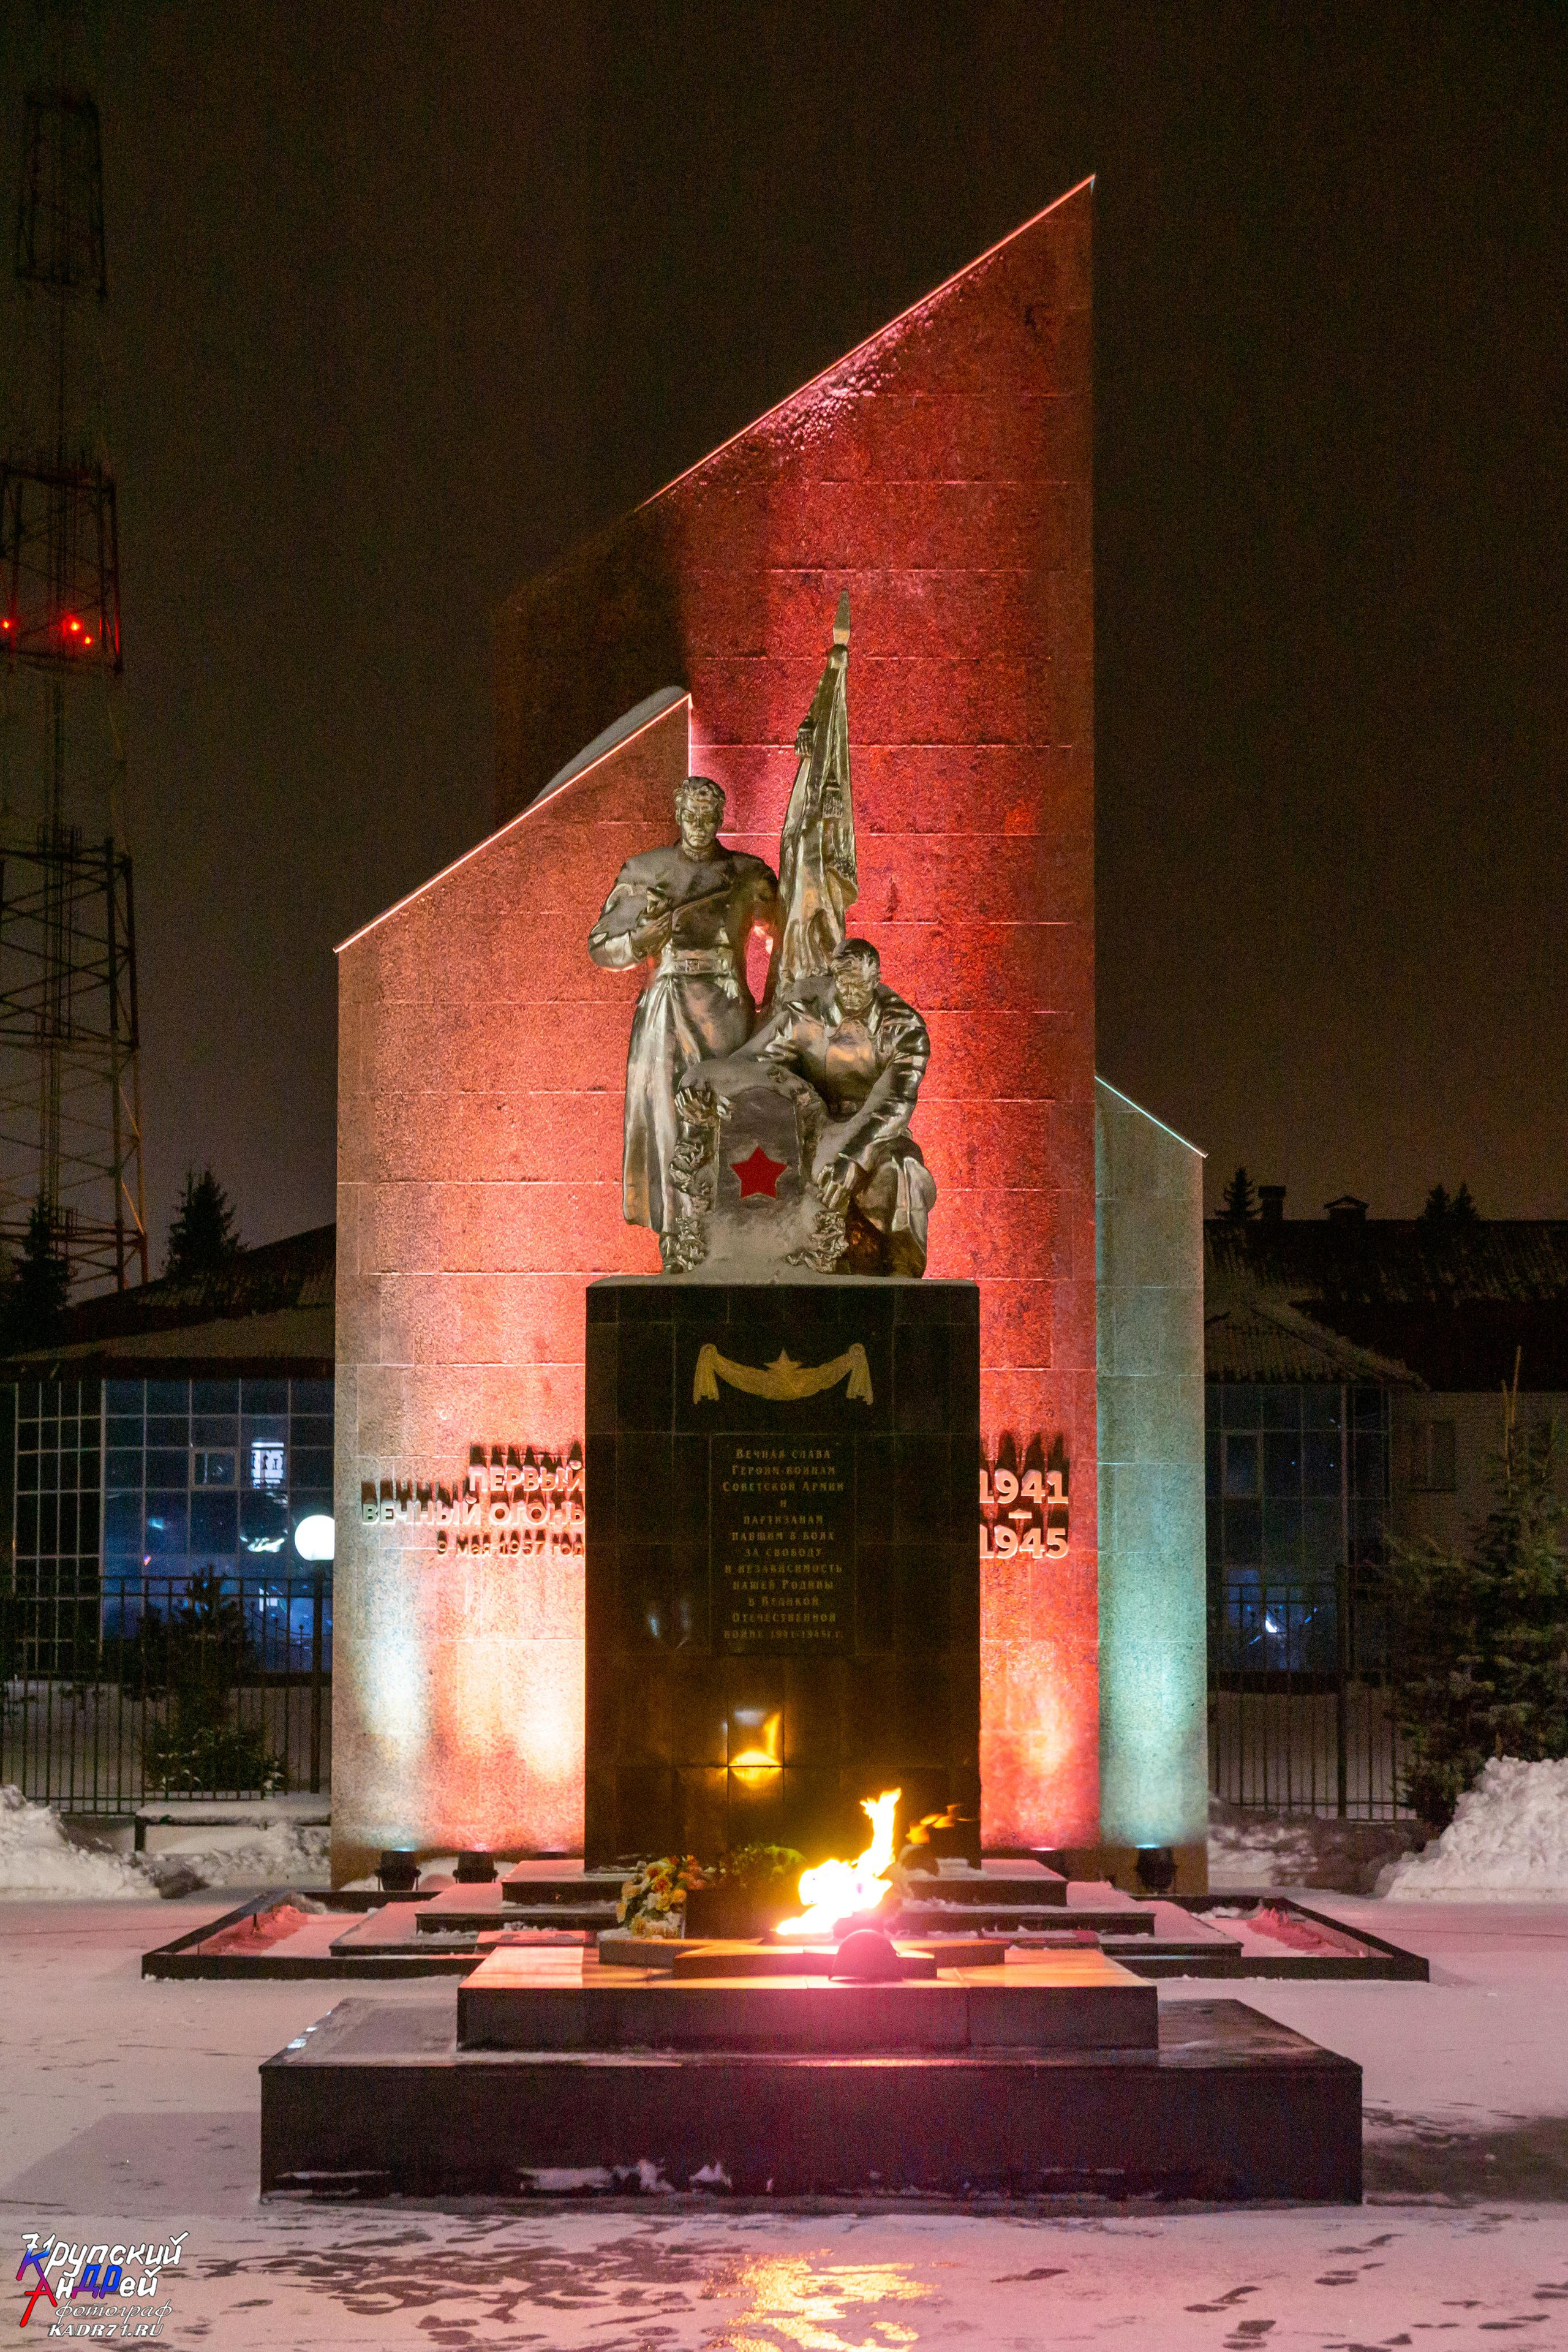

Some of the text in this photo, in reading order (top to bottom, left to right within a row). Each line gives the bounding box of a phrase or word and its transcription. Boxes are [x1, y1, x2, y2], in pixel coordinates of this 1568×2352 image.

[469, 1460, 586, 1491] ПЕРВЫЙ
[979, 1469, 1069, 1504] 1941
[361, 1494, 586, 1526] ВЕЧНЫЙ ОГОНЬ
[743, 1515, 823, 1525] ПАРТИЗАНАМ
[437, 1540, 585, 1559] 9 мая 1957 год
[979, 1524, 1069, 1559] 1945
